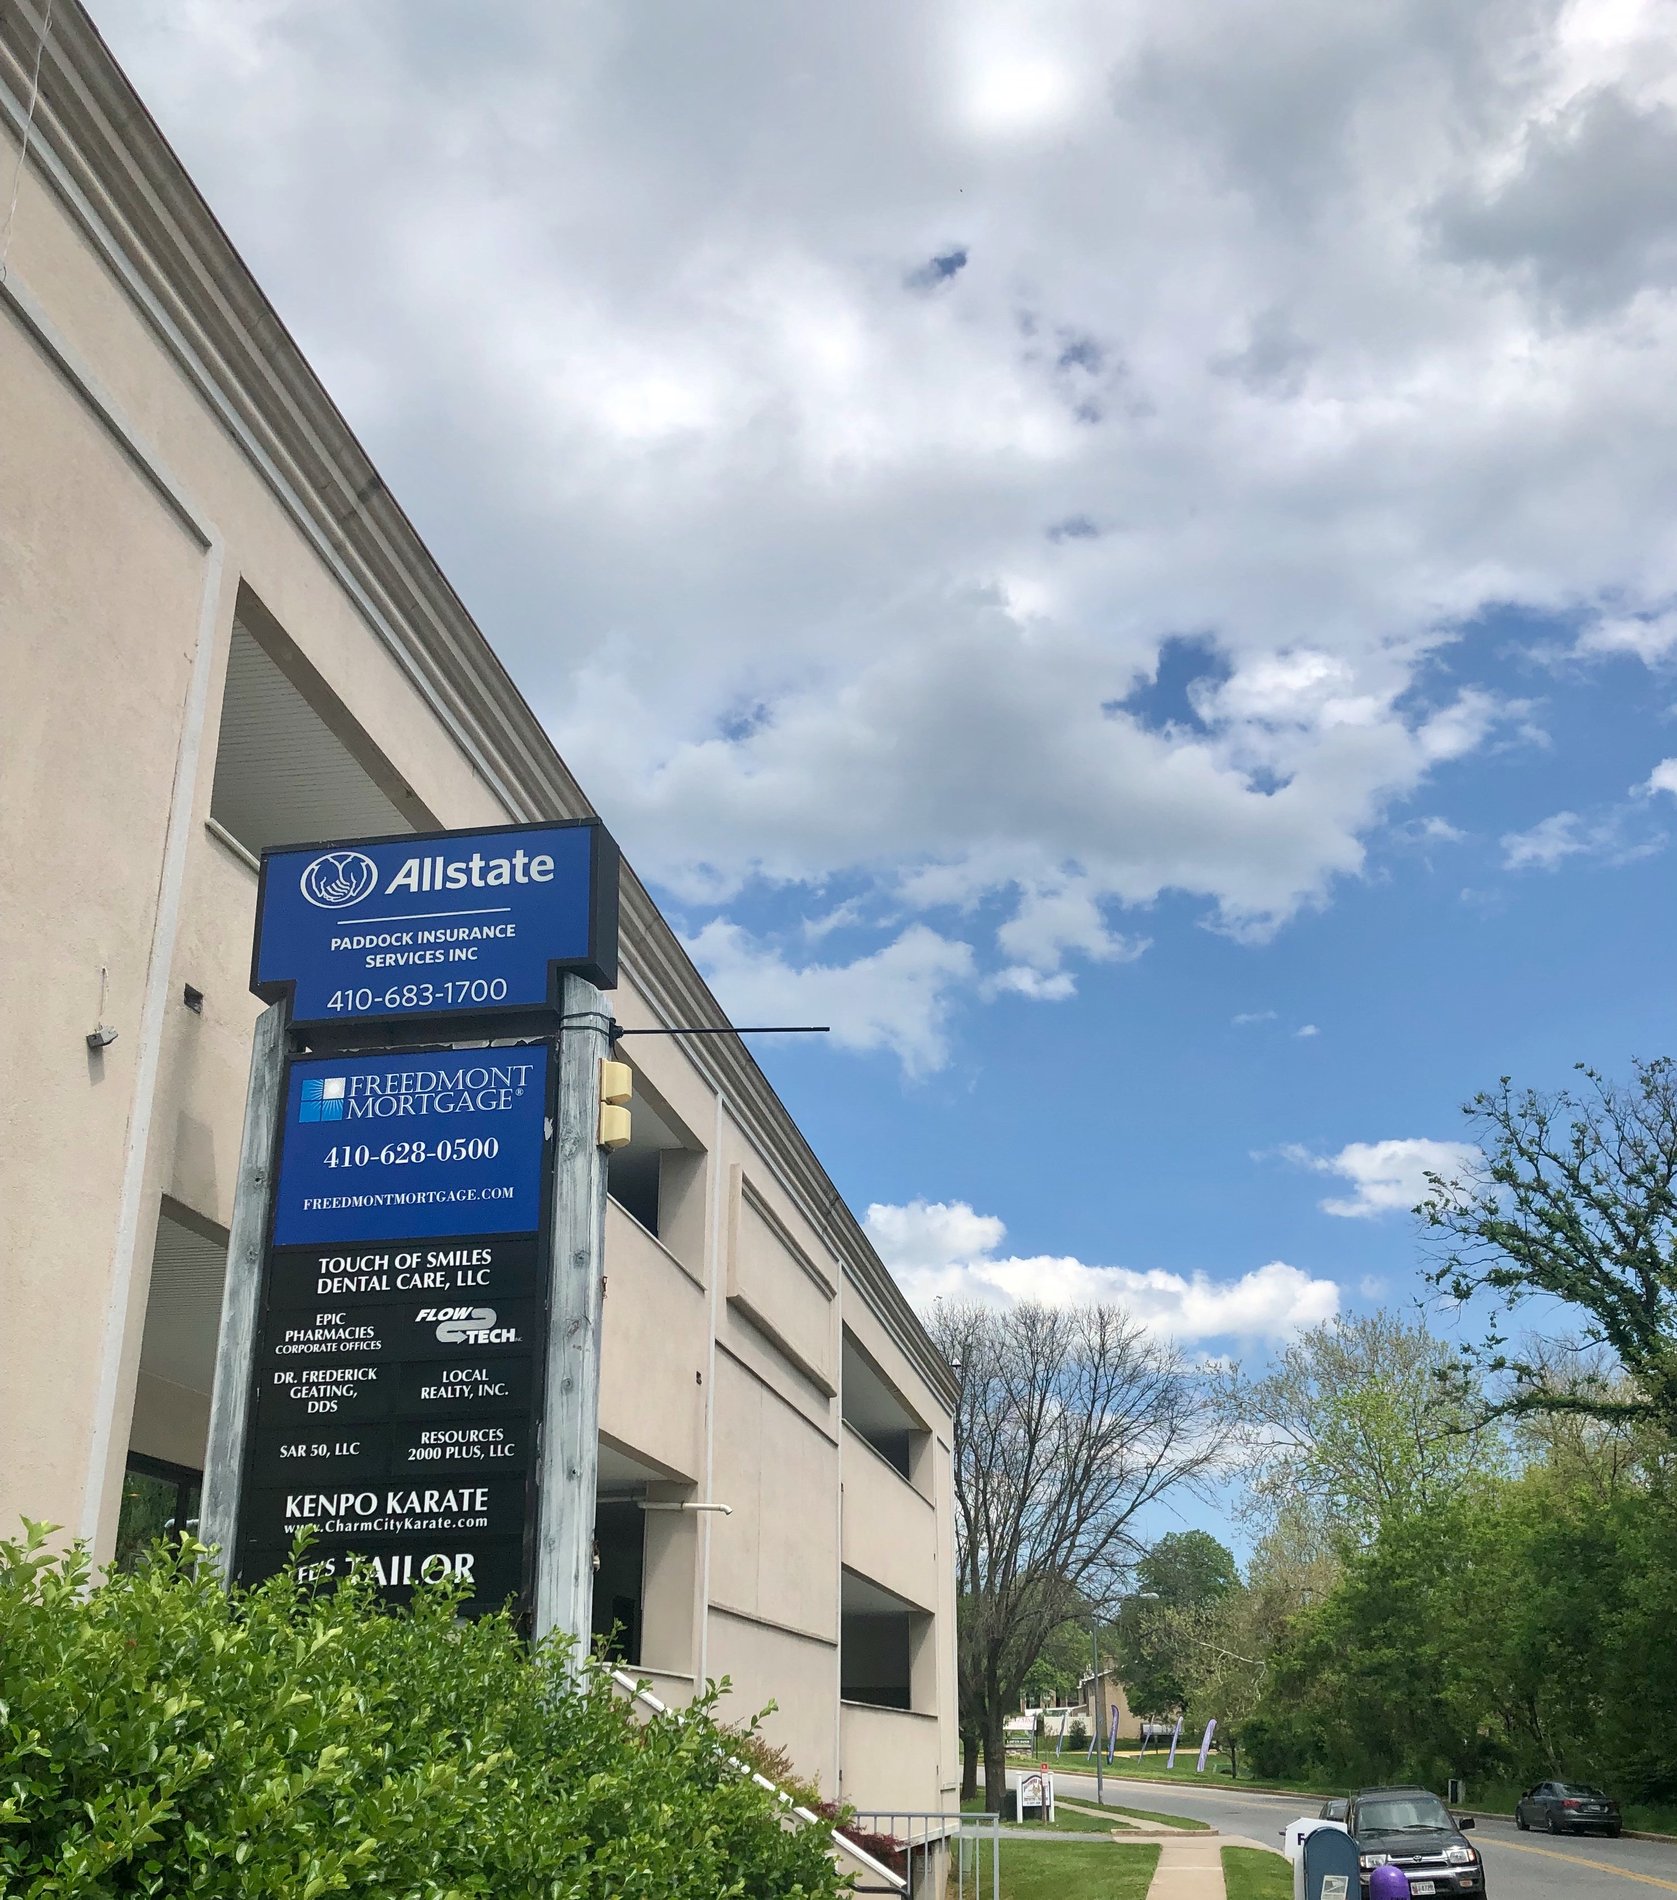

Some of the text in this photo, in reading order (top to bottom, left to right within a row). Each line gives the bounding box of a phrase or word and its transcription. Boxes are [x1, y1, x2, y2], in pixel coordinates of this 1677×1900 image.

[385, 849, 554, 895] Allstate
[331, 924, 516, 951] PADDOCK INSURANCE
[366, 947, 478, 968] SERVICES INC
[327, 978, 508, 1012] 410-683-1700
[350, 1065, 533, 1096] FREEDMONT
[324, 1138, 499, 1168] 410-628-0500
[303, 1187, 514, 1210] FREEDMONTMORTGAGE.COM
[319, 1249, 492, 1274] TOUCH OF SMILES
[317, 1269, 490, 1294] DENTAL CARE, LLC
[316, 1313, 346, 1325] EPIC
[415, 1307, 473, 1322] FLOW
[285, 1326, 374, 1342] PHARMACIES
[466, 1328, 515, 1344] TECH
[275, 1341, 381, 1354] CORPORATE OFFICES
[274, 1368, 377, 1384] DR. FREDERICK
[442, 1369, 489, 1383] LOCAL
[290, 1384, 358, 1399] GEATING,
[421, 1383, 508, 1399] REALTY, INC.
[308, 1400, 338, 1413] DDS
[421, 1428, 504, 1444] RESOURCES
[280, 1442, 360, 1458] SAR 50, LLC
[408, 1444, 515, 1460] 2000 PLUS, LLC
[286, 1488, 489, 1518] KENPO KARATE
